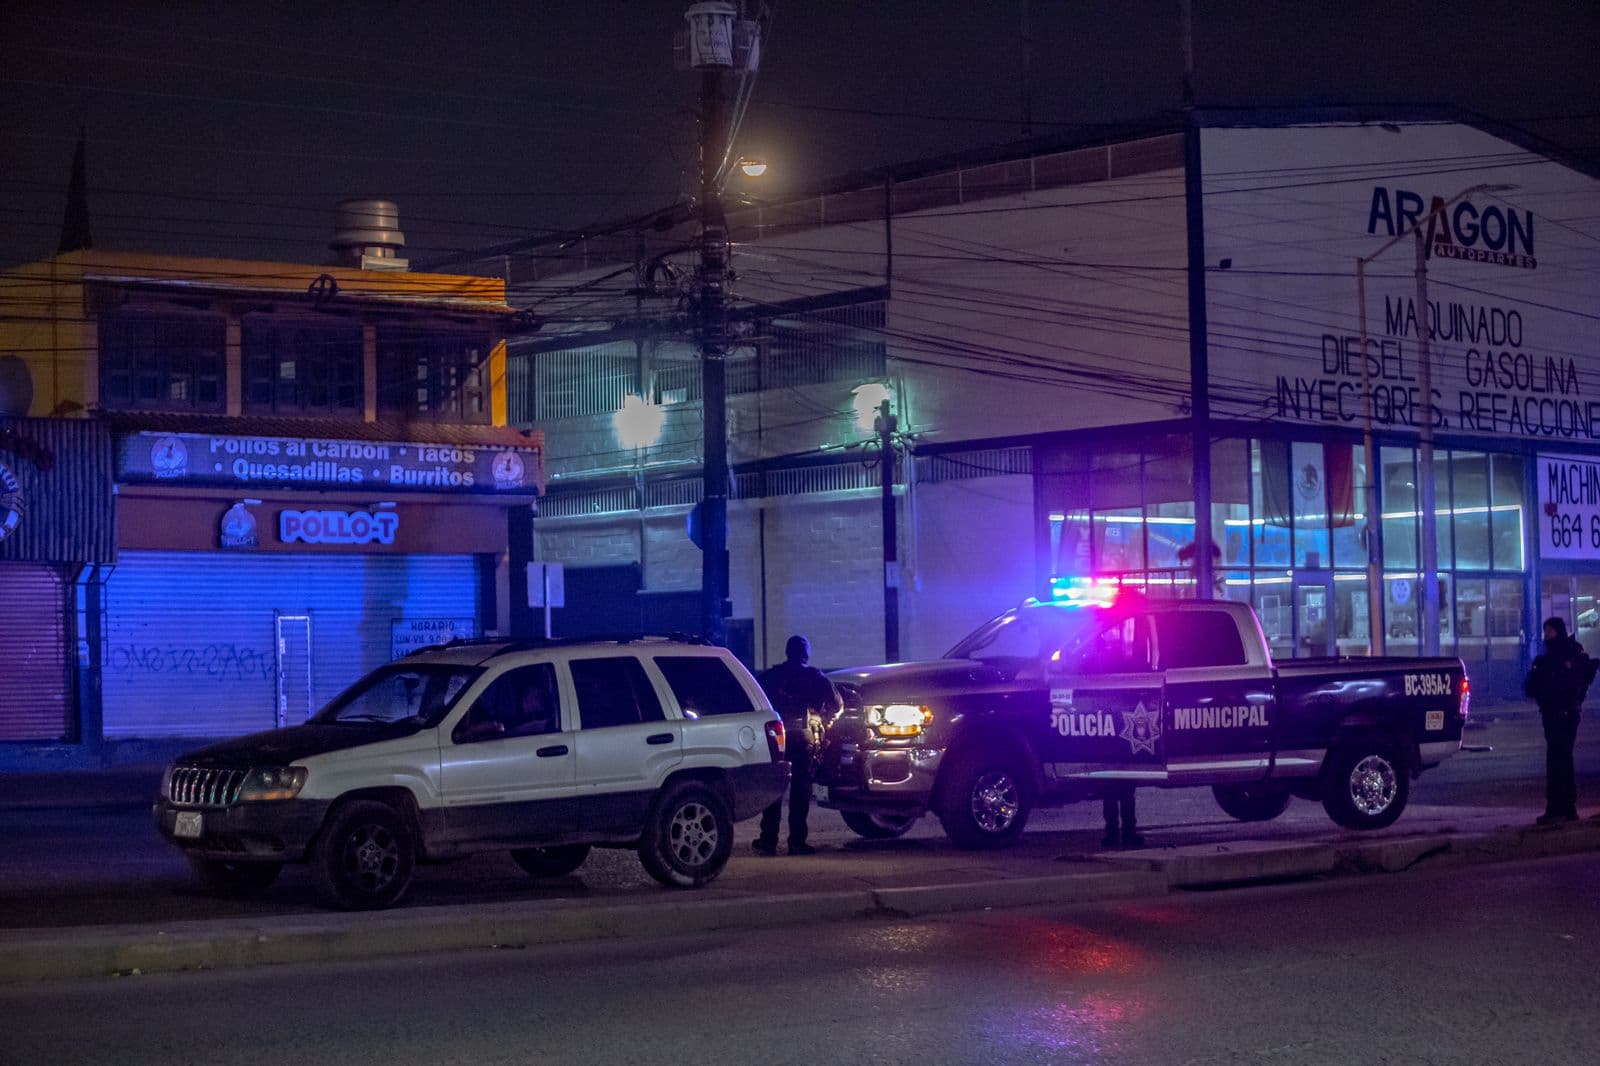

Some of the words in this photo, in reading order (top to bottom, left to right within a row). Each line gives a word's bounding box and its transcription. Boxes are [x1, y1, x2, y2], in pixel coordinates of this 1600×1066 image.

[1367, 187, 1534, 259] ARAGON
[1436, 245, 1537, 268] AUTOPARTES
[1386, 296, 1522, 347] MAQUINADO
[1321, 334, 1415, 381] DIESEL
[1466, 349, 1580, 395] GASOLINA
[1459, 391, 1600, 439] REFACCIONE
[209, 439, 280, 455] Pollos
[417, 447, 475, 463] Tacos
[232, 458, 364, 482] Quesadillas
[389, 464, 475, 486] Burritos
[283, 513, 396, 541] POLLO-T
[1551, 513, 1583, 548] 664
[411, 620, 455, 631] HORARIO
[1404, 673, 1452, 696] BC-395A-2
[1174, 705, 1269, 730] MUNICIPAL
